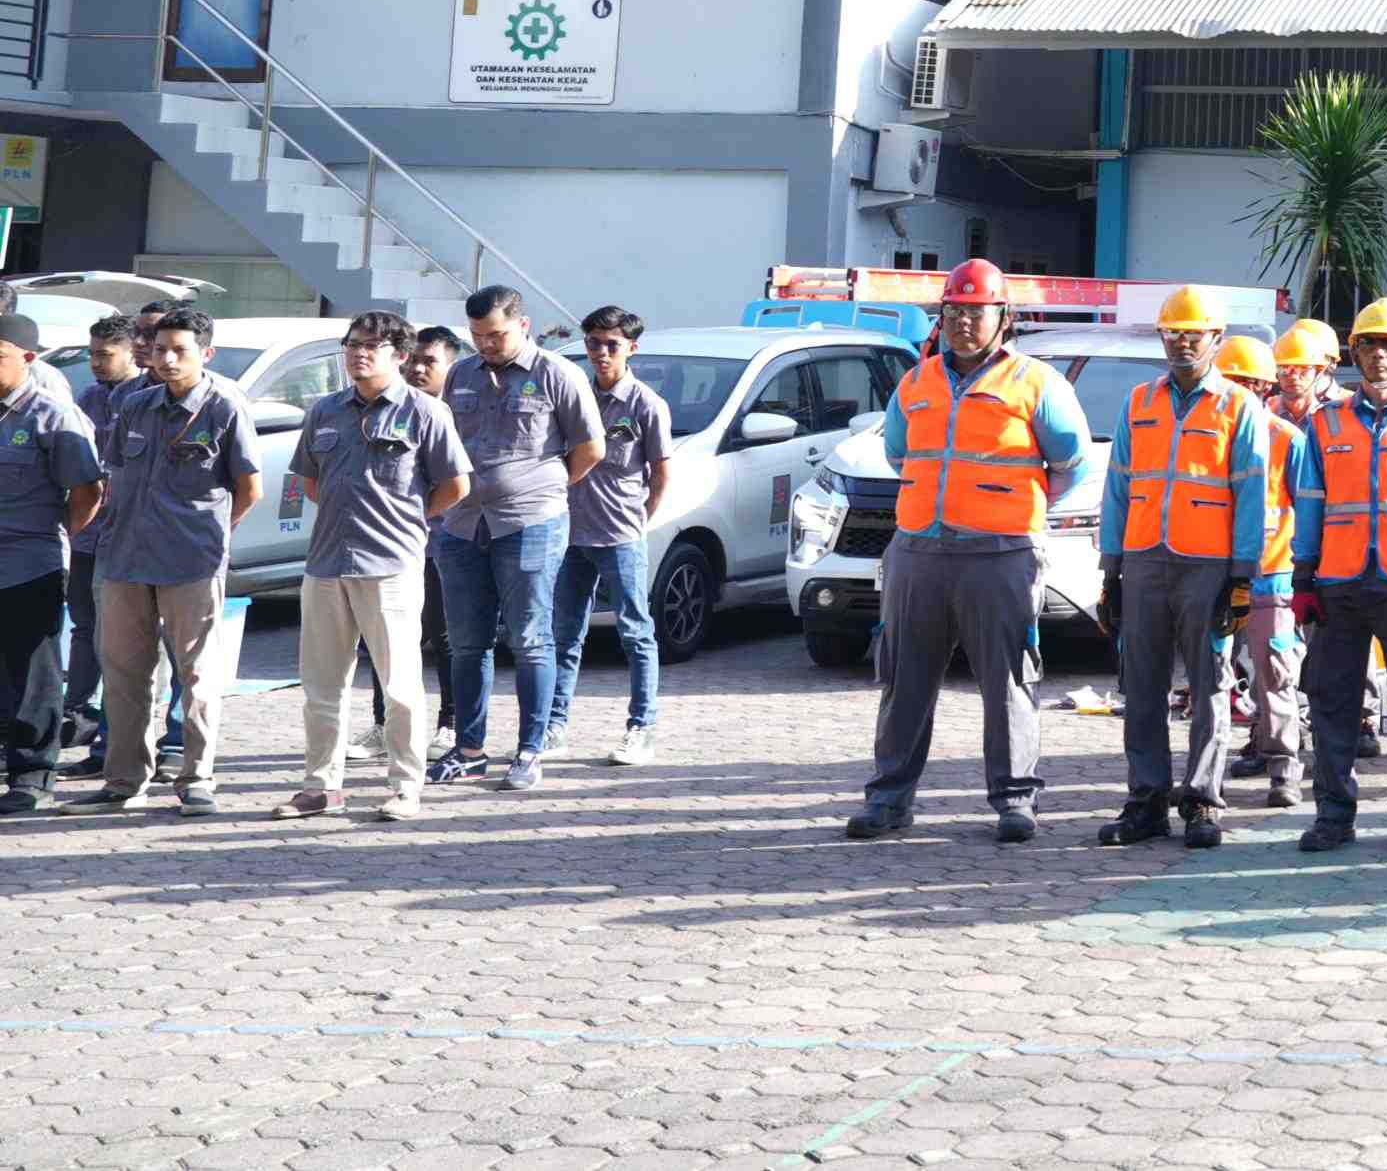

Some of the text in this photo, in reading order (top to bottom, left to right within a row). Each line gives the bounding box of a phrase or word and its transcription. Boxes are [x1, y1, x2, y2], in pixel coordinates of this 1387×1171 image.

[470, 65, 597, 74] UTAMAKAN KESELAMATAN
[475, 75, 588, 85] DAN KESEHATAN KERJA
[3, 168, 33, 180] PLN
[279, 520, 301, 532] PLN
